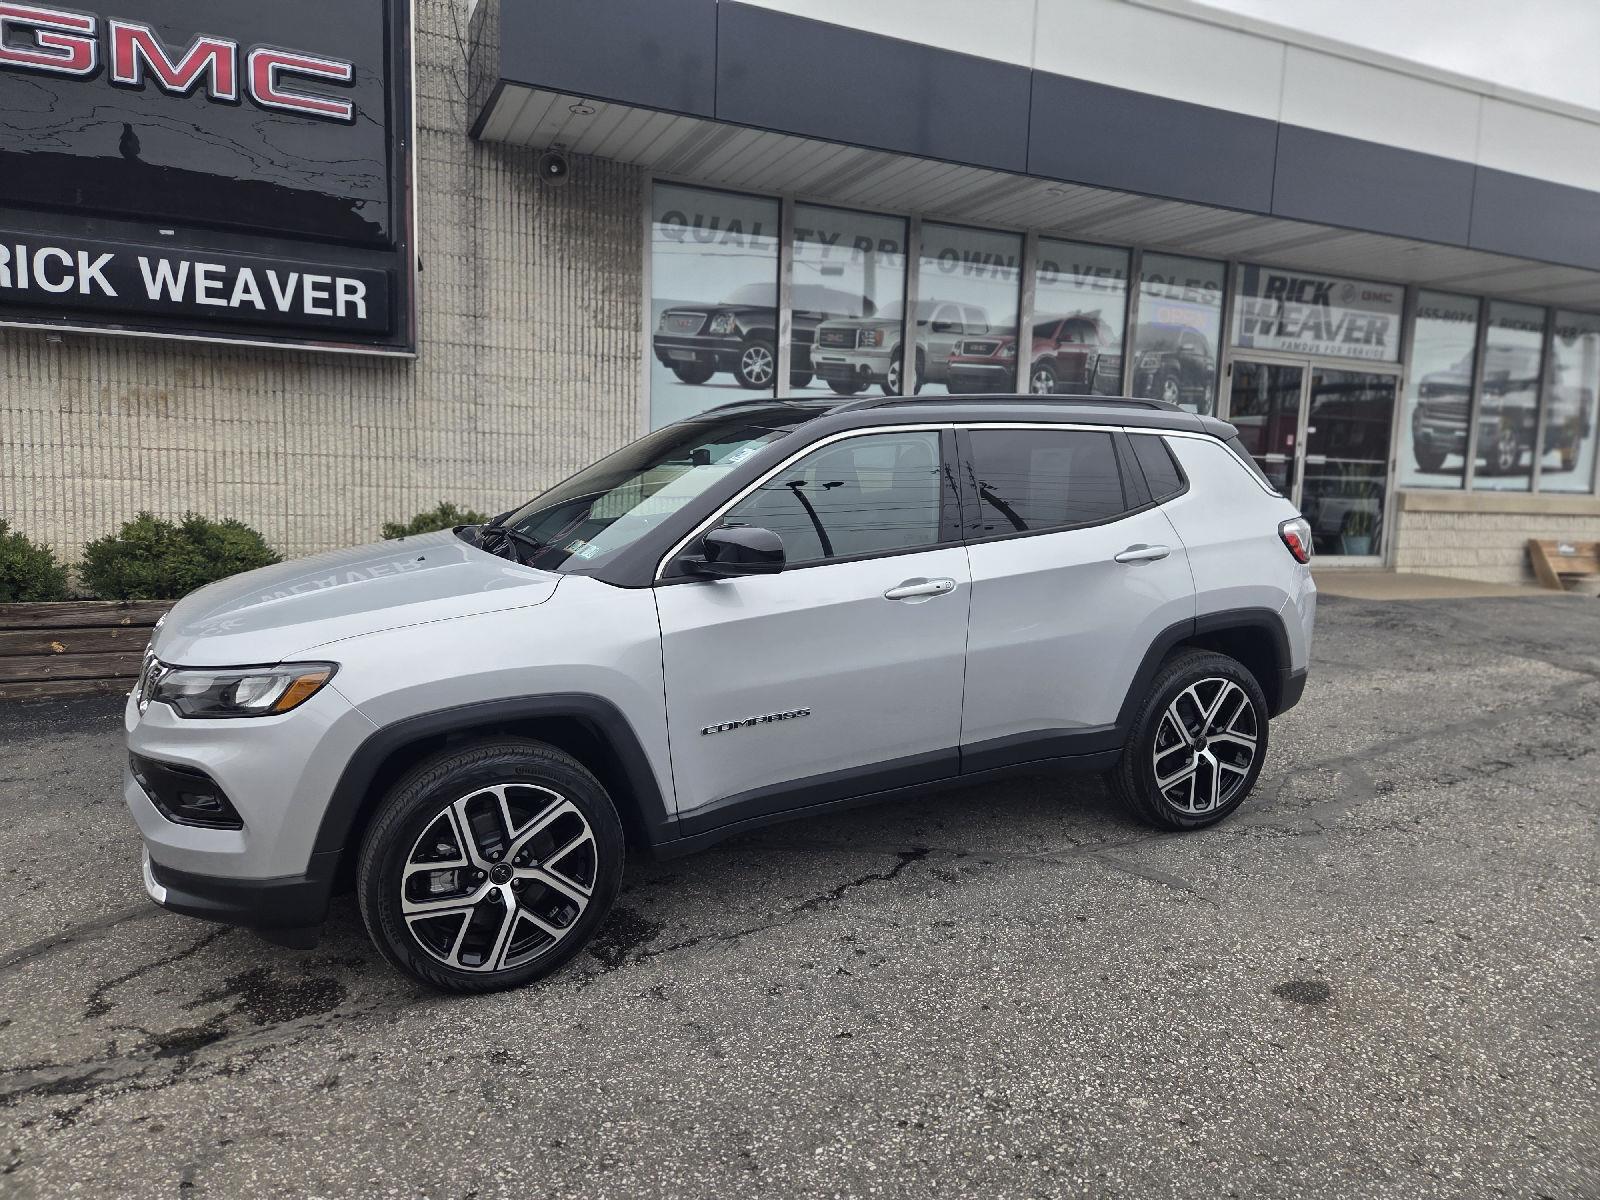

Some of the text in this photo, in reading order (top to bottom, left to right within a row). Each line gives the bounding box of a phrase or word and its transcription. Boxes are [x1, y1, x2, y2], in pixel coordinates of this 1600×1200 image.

[0, 2, 355, 121] GMC
[660, 210, 841, 261] QUALTY
[138, 255, 368, 320] WEAVER
[1264, 274, 1393, 307] RICK GMC
[1242, 300, 1391, 347] WEAVER
[701, 707, 811, 735] COMPASS
